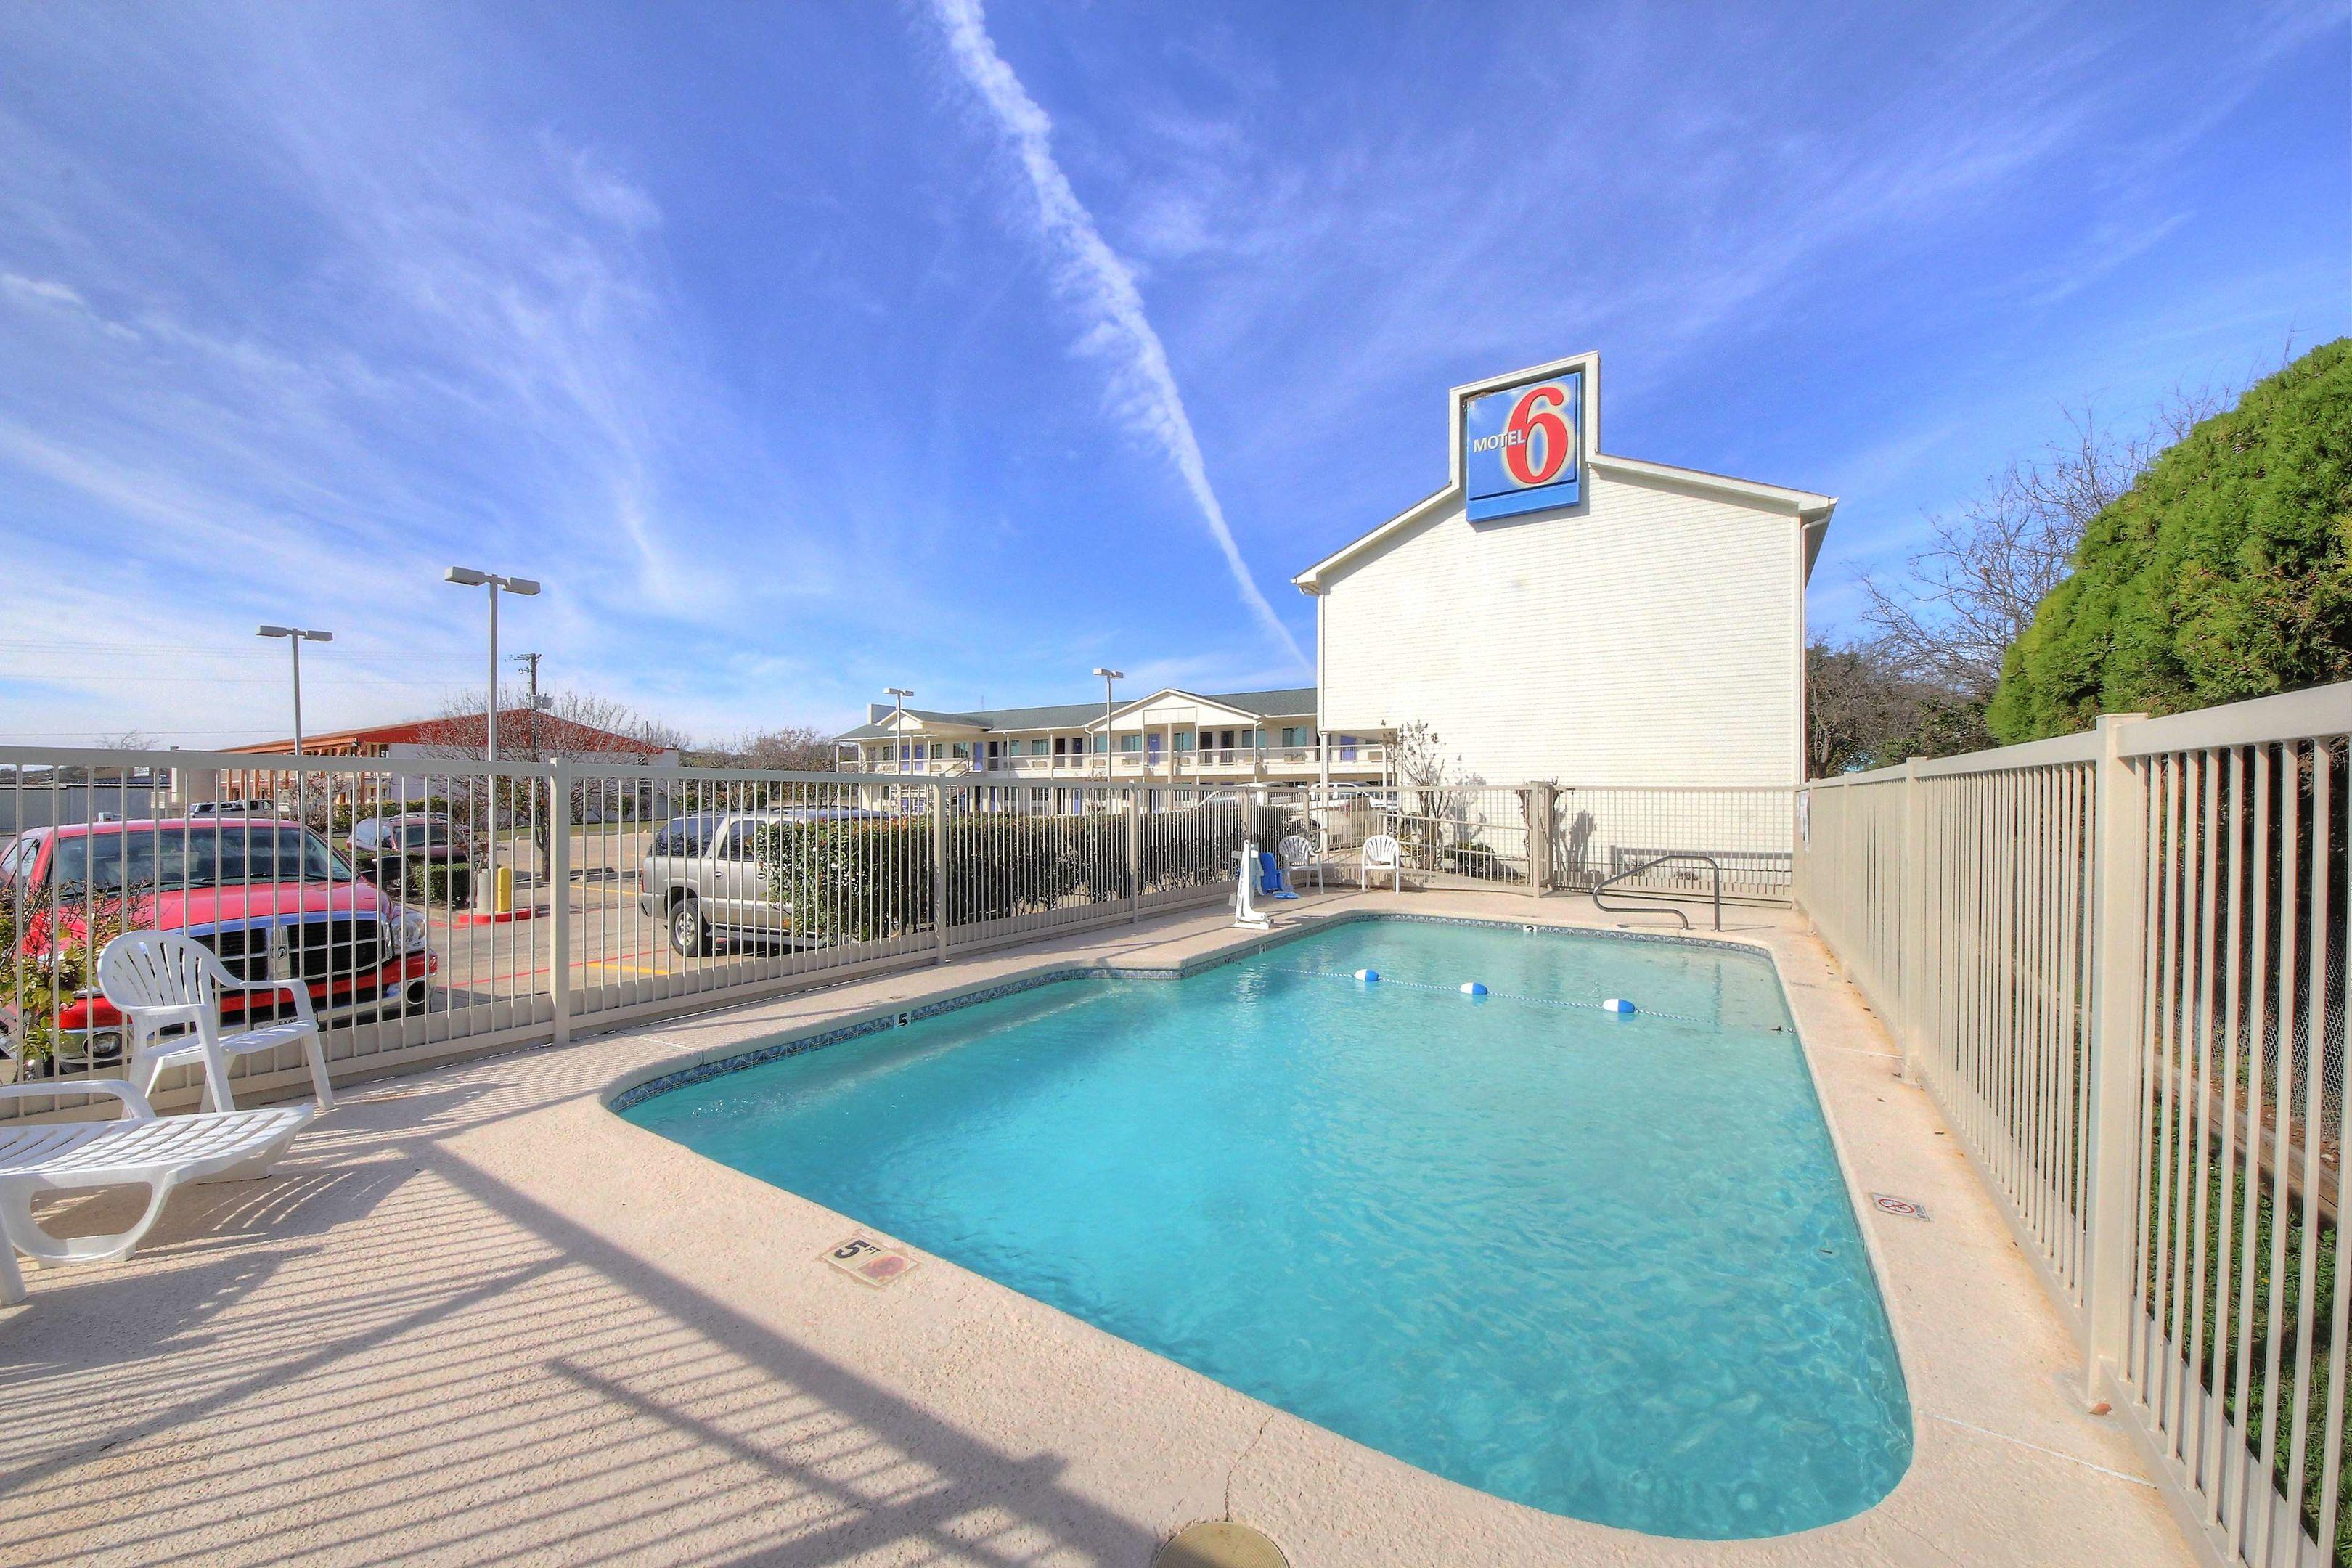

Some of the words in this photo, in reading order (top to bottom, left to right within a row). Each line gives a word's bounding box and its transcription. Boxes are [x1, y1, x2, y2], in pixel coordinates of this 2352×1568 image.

[1474, 429, 1527, 453] MOTEL
[1506, 386, 1569, 484] 6
[897, 1013, 908, 1027] 5
[835, 1239, 870, 1259] 5
[864, 1246, 881, 1255] FT
